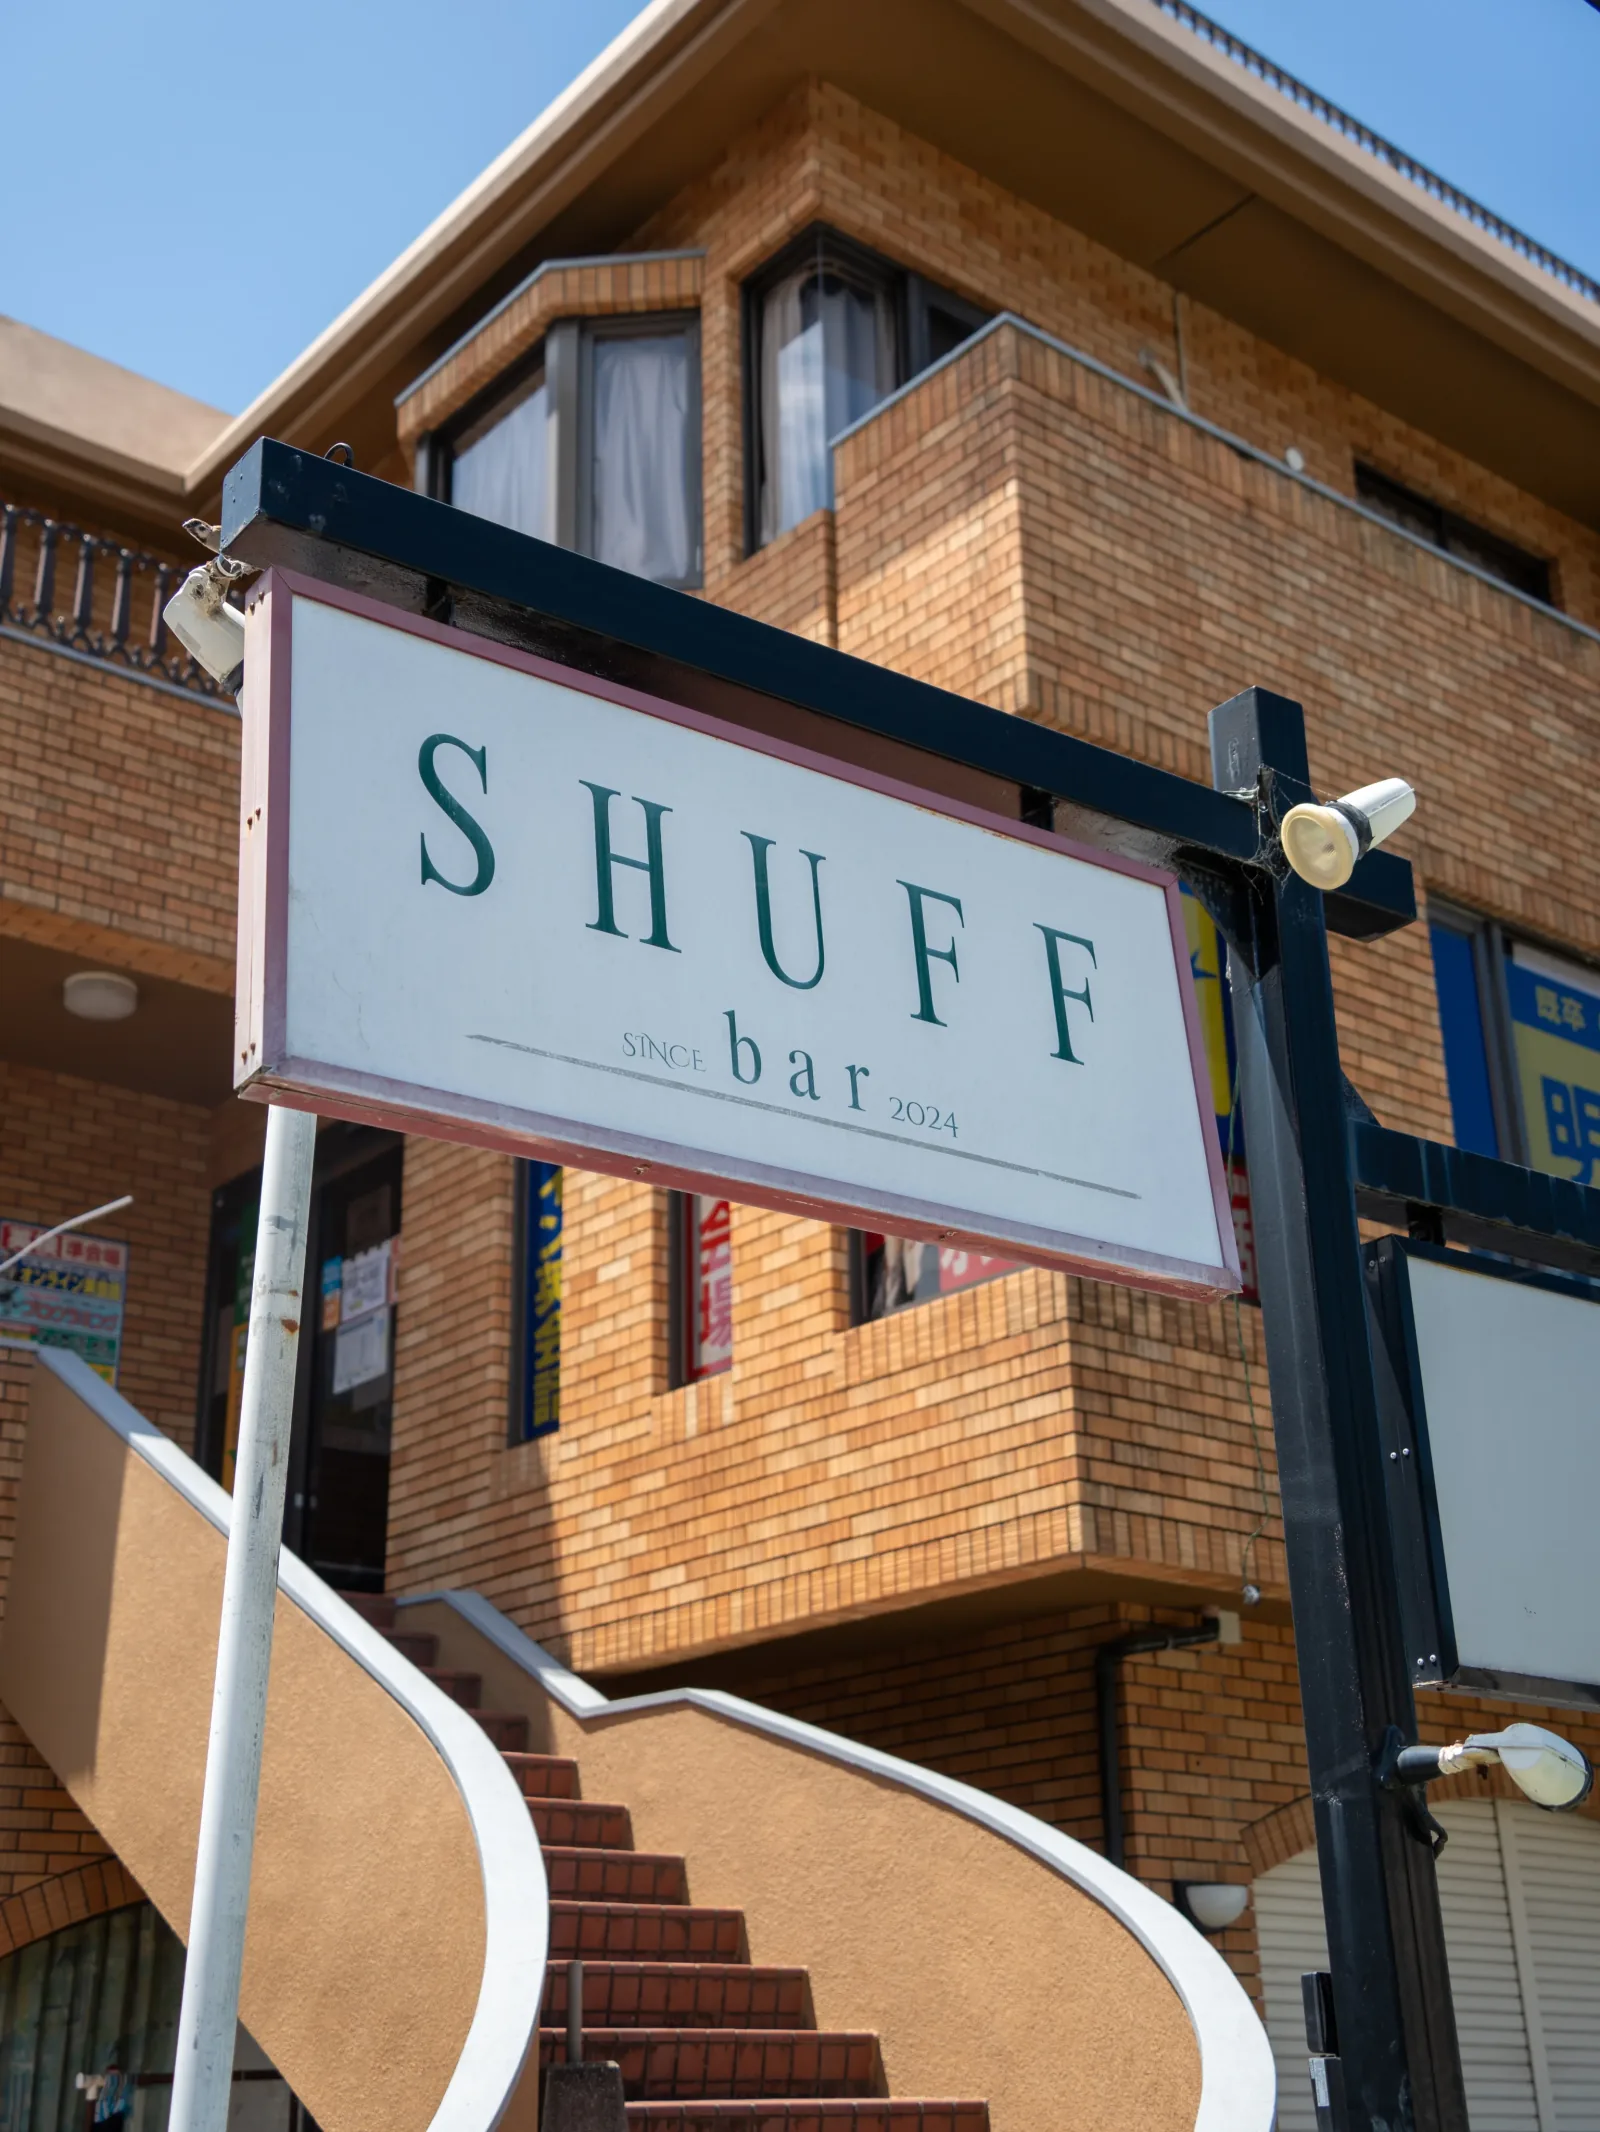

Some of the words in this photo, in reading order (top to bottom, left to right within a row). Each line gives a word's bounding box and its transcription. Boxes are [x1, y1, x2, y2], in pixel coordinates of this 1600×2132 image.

[418, 733, 1098, 1066] SHUFF
[622, 1032, 706, 1073] SINCE
[722, 1009, 870, 1112] bar
[889, 1096, 959, 1139] 2024
